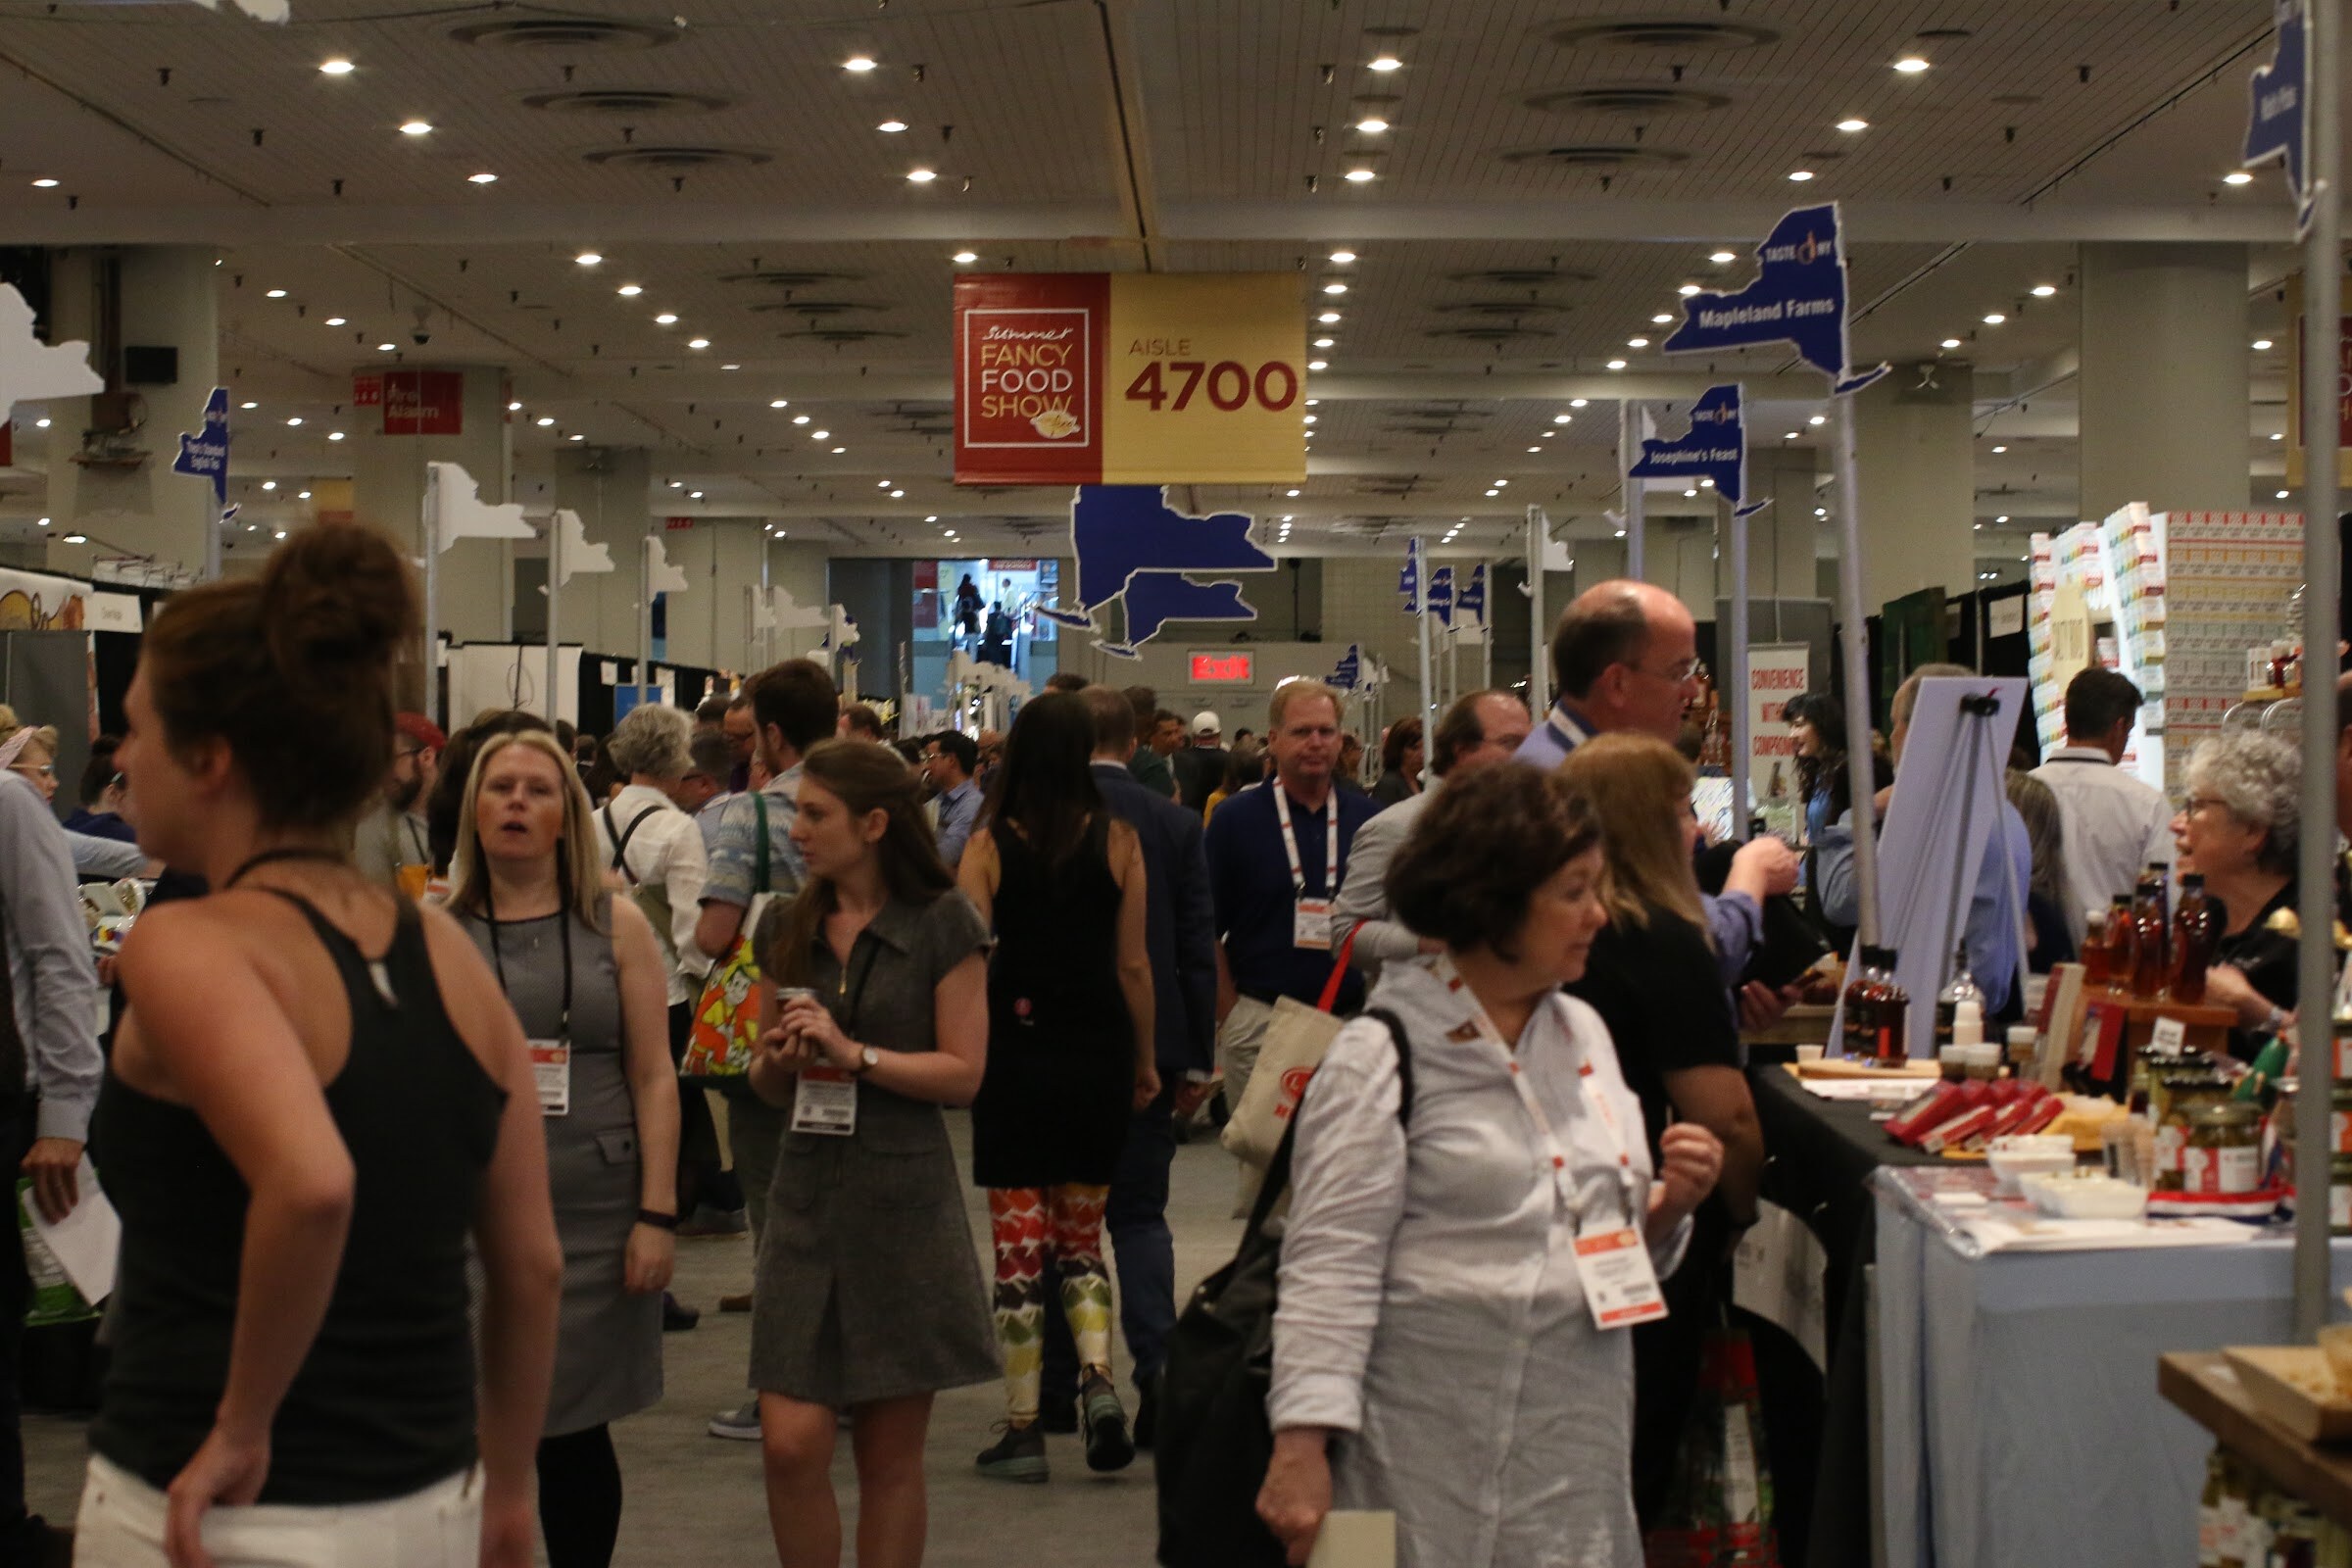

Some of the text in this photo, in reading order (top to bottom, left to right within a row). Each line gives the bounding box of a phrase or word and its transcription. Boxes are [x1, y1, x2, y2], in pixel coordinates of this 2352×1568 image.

[1699, 299, 1835, 328] Mapleland Farms
[981, 324, 1074, 341] Summer
[981, 343, 1074, 367] FANCY
[1128, 338, 1192, 357] AISLE
[981, 368, 1074, 393] FOOD
[1125, 360, 1298, 413] 4700
[981, 394, 1074, 418] SHOW
[1650, 449, 1738, 466] Josephine's Feast
[1751, 668, 1804, 690] CONVENIENCE
